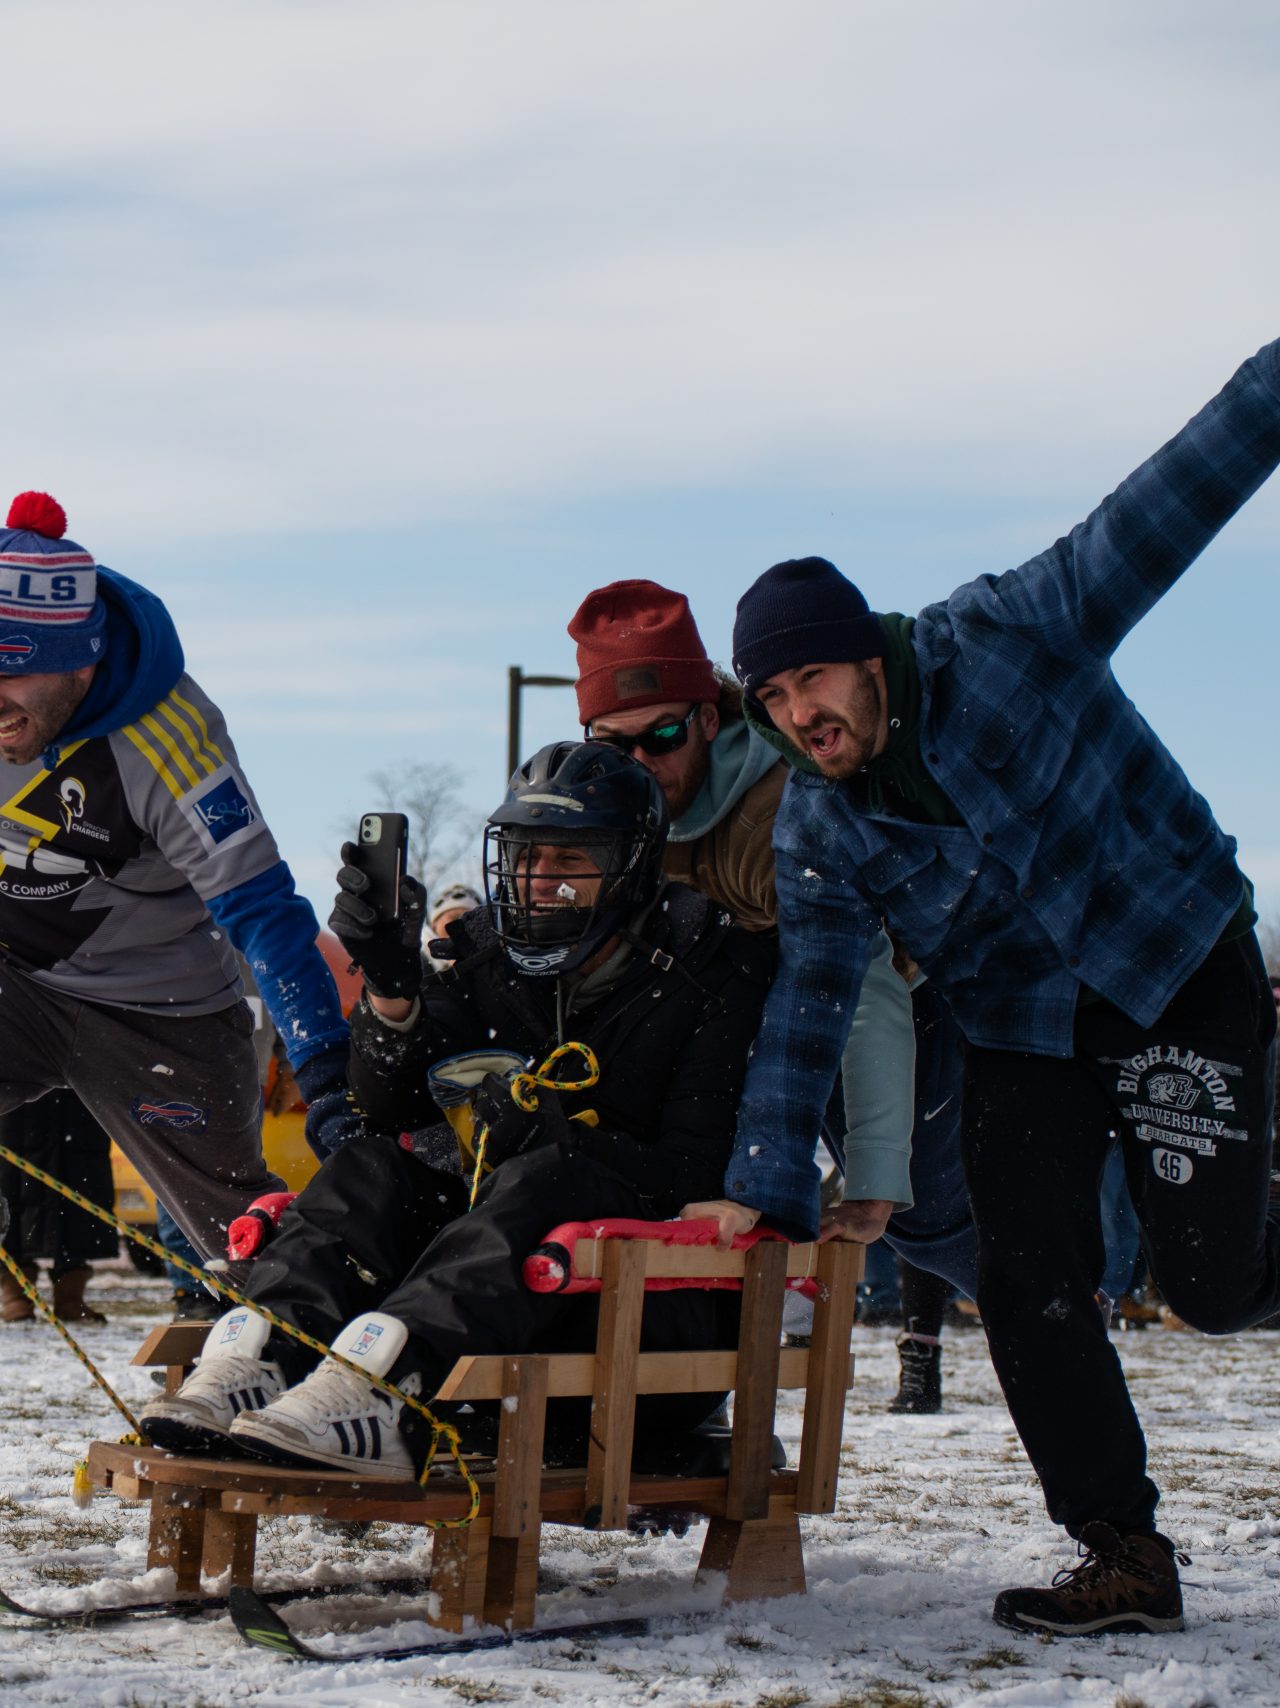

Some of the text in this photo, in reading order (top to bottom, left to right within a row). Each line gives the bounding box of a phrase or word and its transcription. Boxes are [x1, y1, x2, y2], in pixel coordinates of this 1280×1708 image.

[71, 823, 110, 843] CHARGERS
[12, 880, 71, 896] COMPANY
[1130, 1103, 1226, 1136] UNIVERSITY
[1145, 1126, 1207, 1149] BEARCATS
[1159, 1151, 1181, 1182] 46
